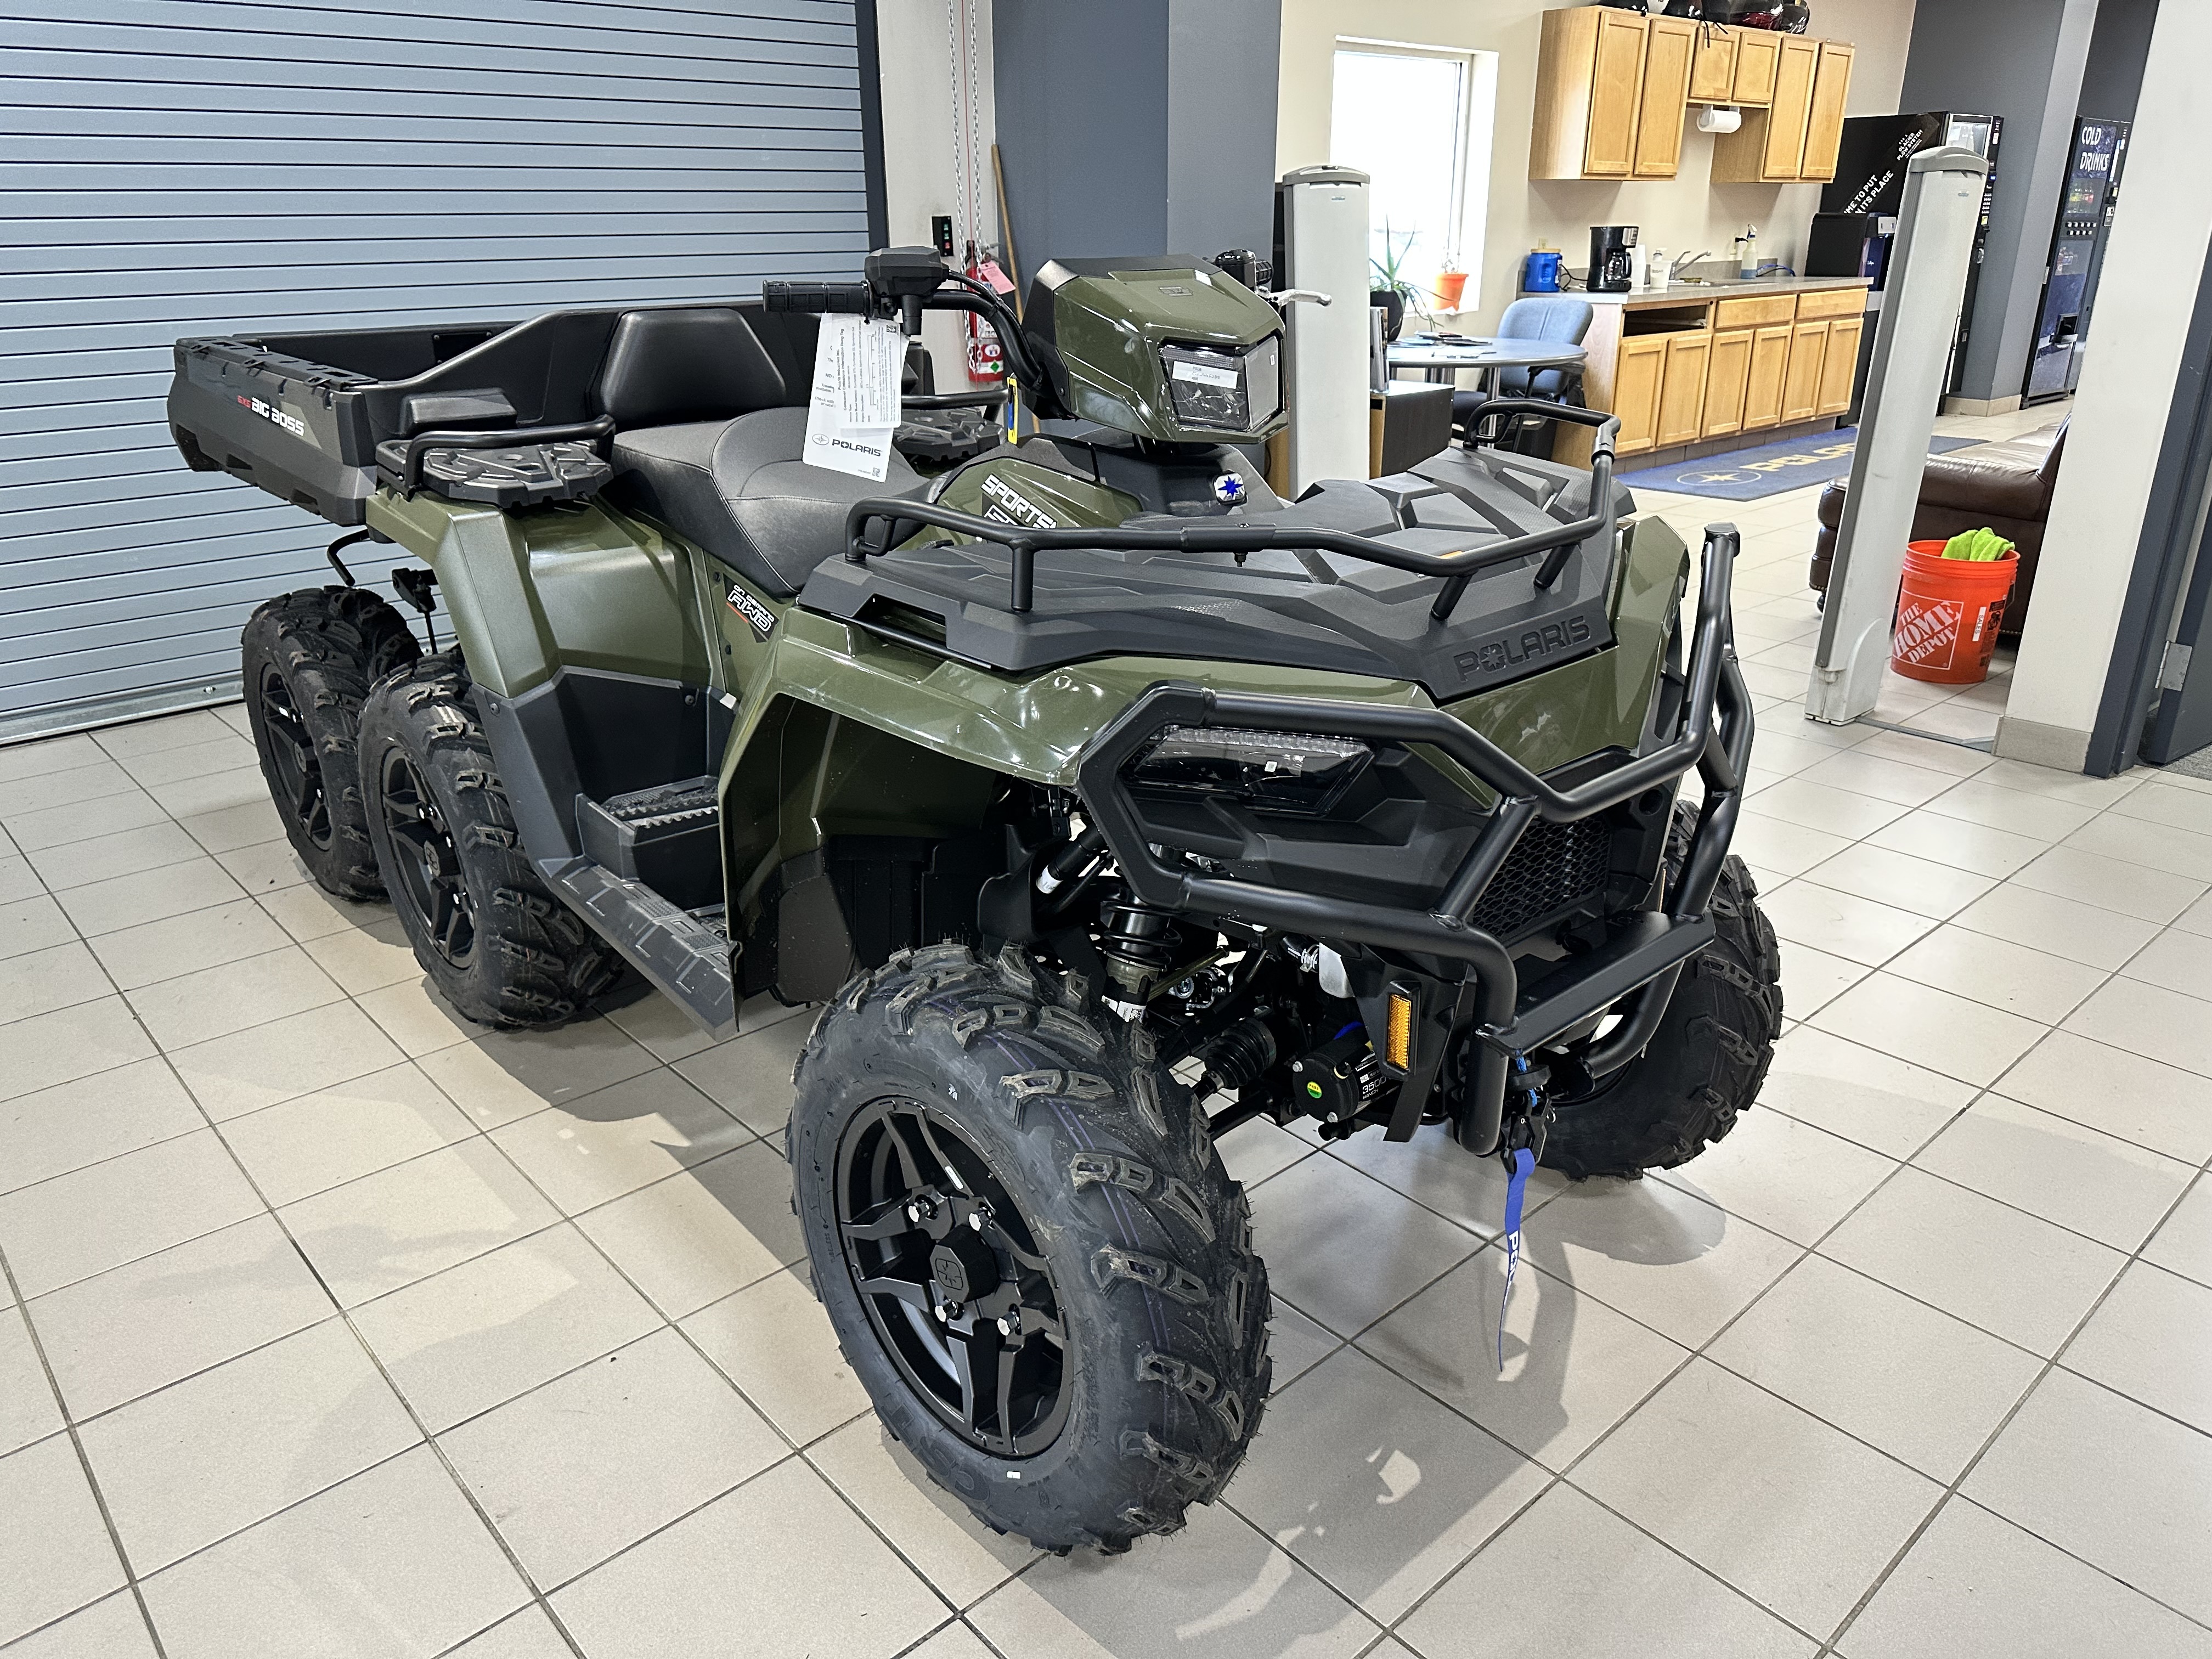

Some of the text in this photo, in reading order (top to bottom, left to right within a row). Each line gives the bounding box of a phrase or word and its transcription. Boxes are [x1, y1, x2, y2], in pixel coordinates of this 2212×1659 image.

[1897, 147, 1909, 161] PLOW
[1908, 129, 1923, 148] SYSTEM
[1899, 133, 1915, 151] GLACIER
[2081, 126, 2102, 145] COLD
[2079, 151, 2110, 172] DRINKS
[1854, 191, 1865, 201] TO
[1863, 174, 1877, 192] PUT
[1860, 196, 1872, 210] ITS
[1871, 170, 1894, 197] PLACE
[252, 397, 269, 418] BIG
[271, 407, 304, 436] BOSS
[832, 439, 881, 456] POLARIS
[980, 473, 1058, 528] SPORTS
[1900, 602, 1923, 627] THE
[1975, 614, 1984, 634] SALES
[1893, 601, 1960, 658] HOME
[1454, 616, 1590, 683] POLARIS
[1907, 627, 1955, 663] DEPOT
[1362, 1076, 1386, 1094] 3500
